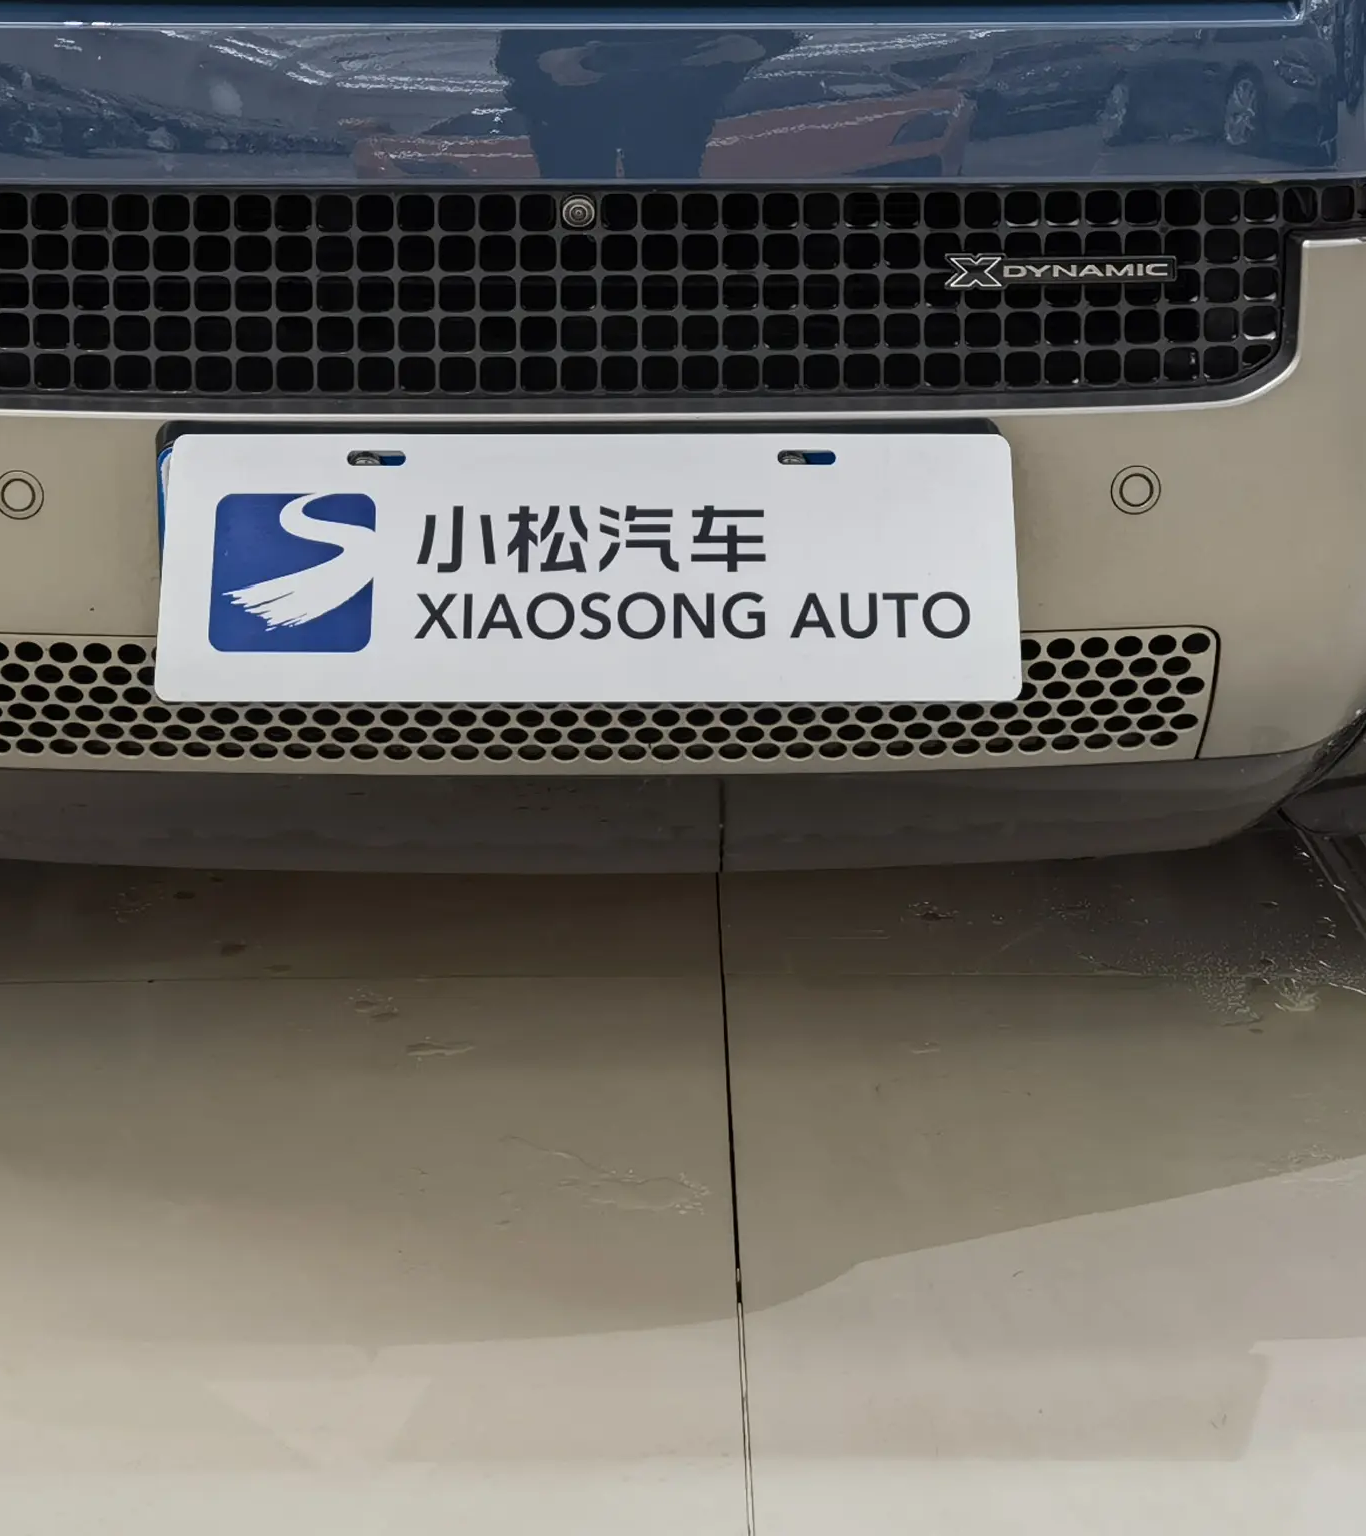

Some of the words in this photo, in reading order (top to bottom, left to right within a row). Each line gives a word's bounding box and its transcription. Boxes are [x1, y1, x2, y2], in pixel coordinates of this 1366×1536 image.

[415, 504, 768, 573] 小松汽车
[414, 590, 767, 640] XIAOSONG
[789, 590, 973, 640] AUTO
